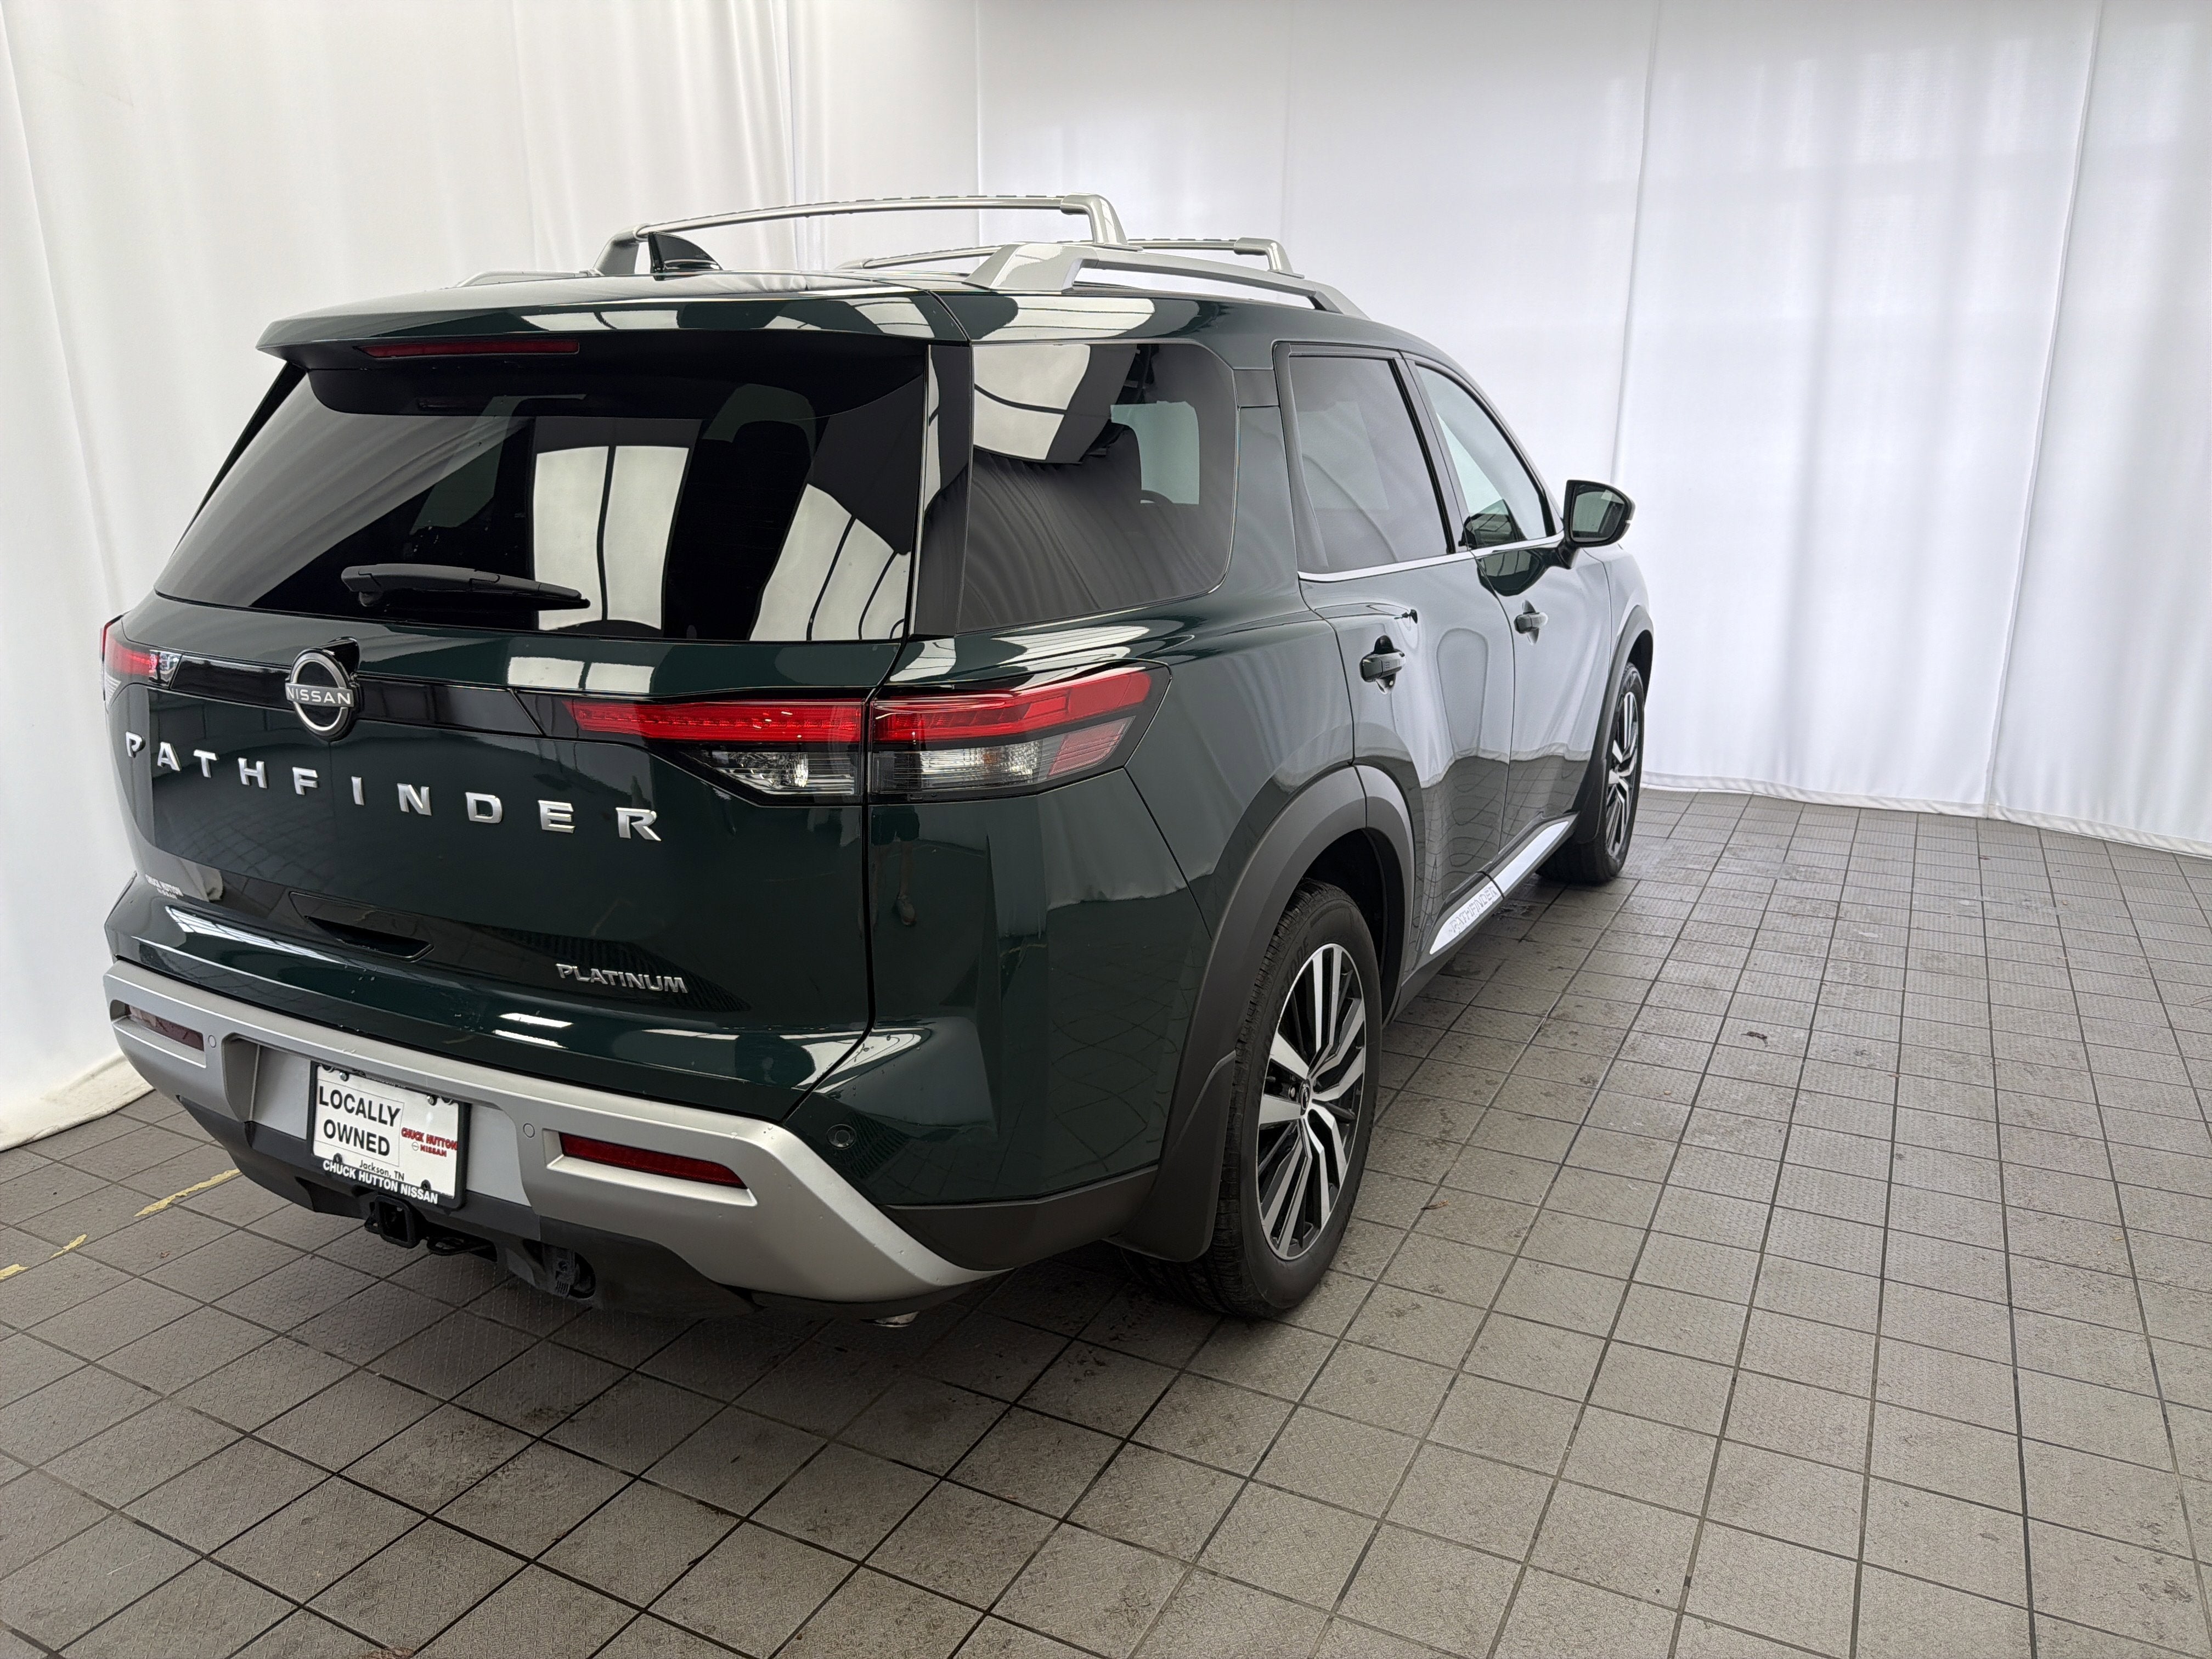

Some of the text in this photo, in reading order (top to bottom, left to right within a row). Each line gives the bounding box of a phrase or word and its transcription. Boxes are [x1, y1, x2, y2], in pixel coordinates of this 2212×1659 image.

[286, 686, 351, 705] NISSAN
[125, 731, 662, 842] PATHFINDER
[555, 963, 689, 994] PLATINUM
[319, 1086, 402, 1127] LOCALLY
[323, 1119, 390, 1156] OWNED
[401, 1127, 458, 1150] CHUCK HUTTON
[323, 1160, 438, 1204] CHUCK HUTTON NISSAN
[359, 1159, 405, 1181] Jackson, TN
